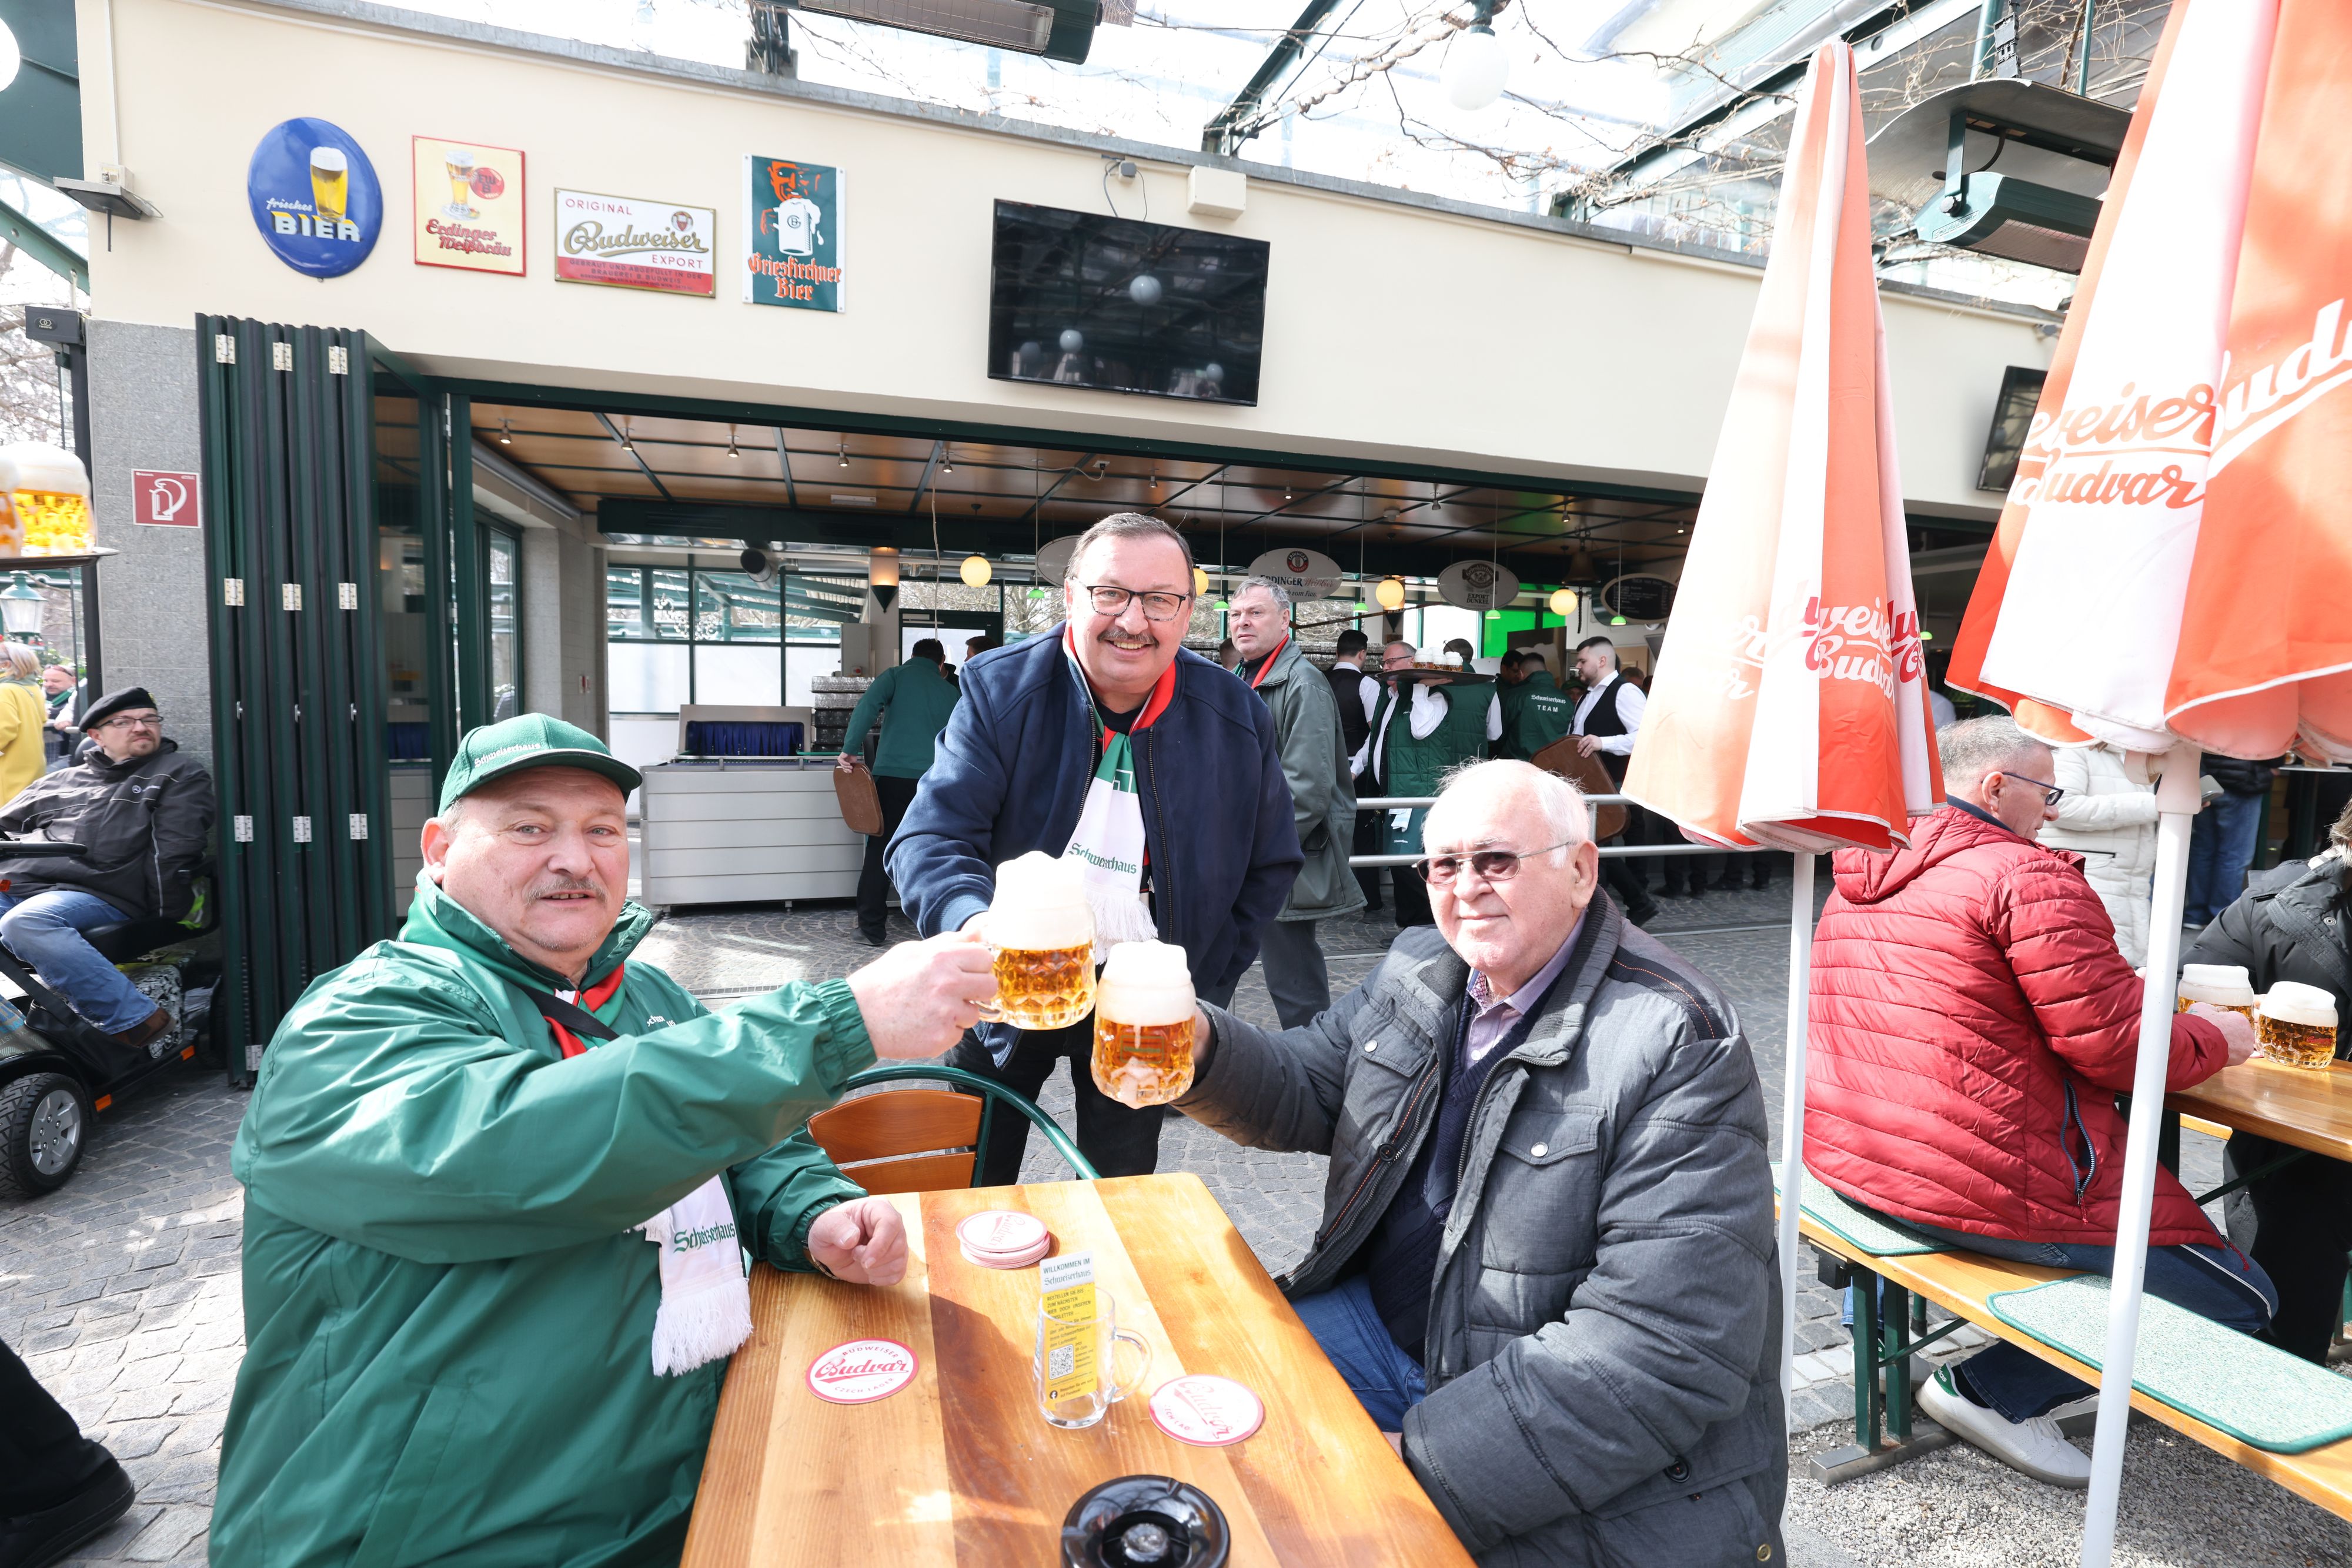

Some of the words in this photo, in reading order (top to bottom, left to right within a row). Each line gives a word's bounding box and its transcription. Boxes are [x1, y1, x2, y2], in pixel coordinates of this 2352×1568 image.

[565, 198, 633, 216] ORIGINAL
[271, 210, 362, 243] BIER
[426, 218, 497, 241] Erdinger
[563, 220, 709, 258] Budweiser
[652, 254, 703, 269] EXPORT
[747, 252, 842, 285] Grieskirchner
[774, 276, 814, 301] Bier
[1531, 694, 1566, 704] Schweizerhaus
[1537, 704, 1558, 713] TEAM
[474, 743, 541, 768] Schweizerhaus
[1043, 1260, 1082, 1275] WILLKOMMEN
[1083, 1258, 1090, 1266] IM
[1044, 1269, 1091, 1286] Schweizerhaus
[841, 1346, 898, 1359] BUDWEISER
[814, 1358, 909, 1379] Budvar
[867, 1378, 895, 1392] LAGER
